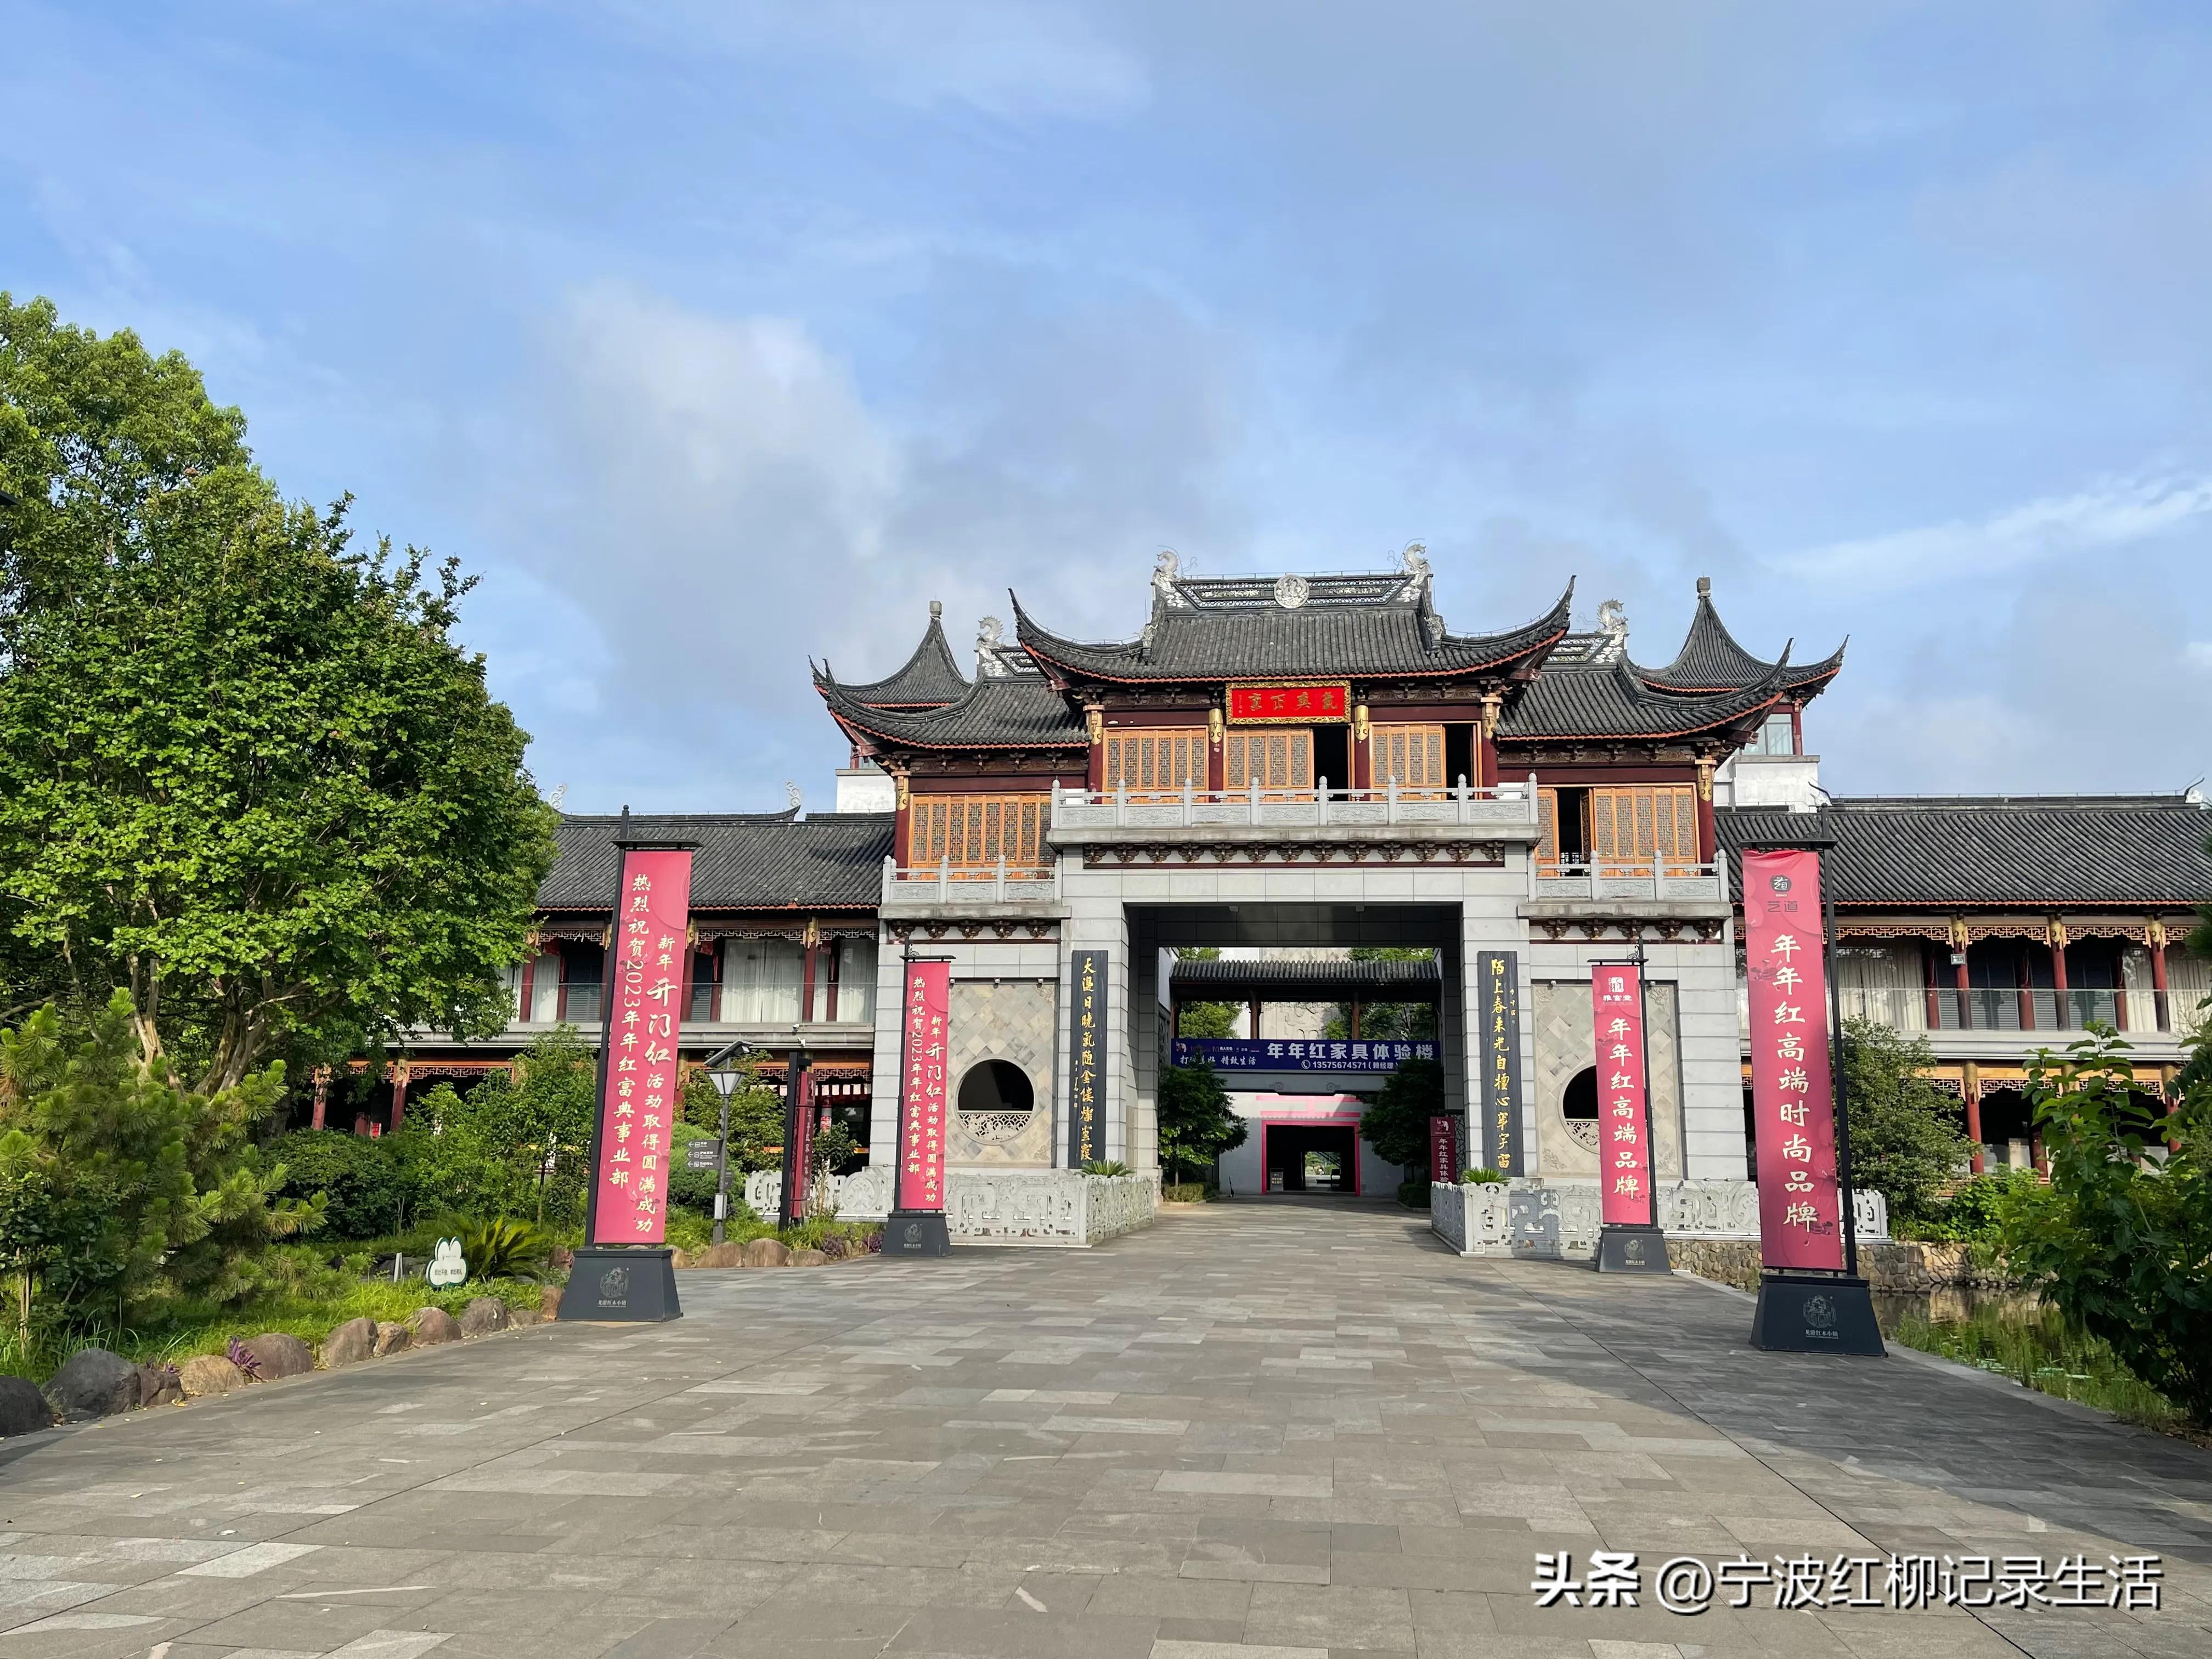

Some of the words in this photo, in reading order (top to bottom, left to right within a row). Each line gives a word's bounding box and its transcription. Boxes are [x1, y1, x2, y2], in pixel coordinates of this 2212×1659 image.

[1267, 1042, 1434, 1060] 年年红家具体验楼
[1607, 1018, 1639, 1199] 年年红高端品牌
[1770, 934, 1819, 1233] 年年红高端时尚品牌
